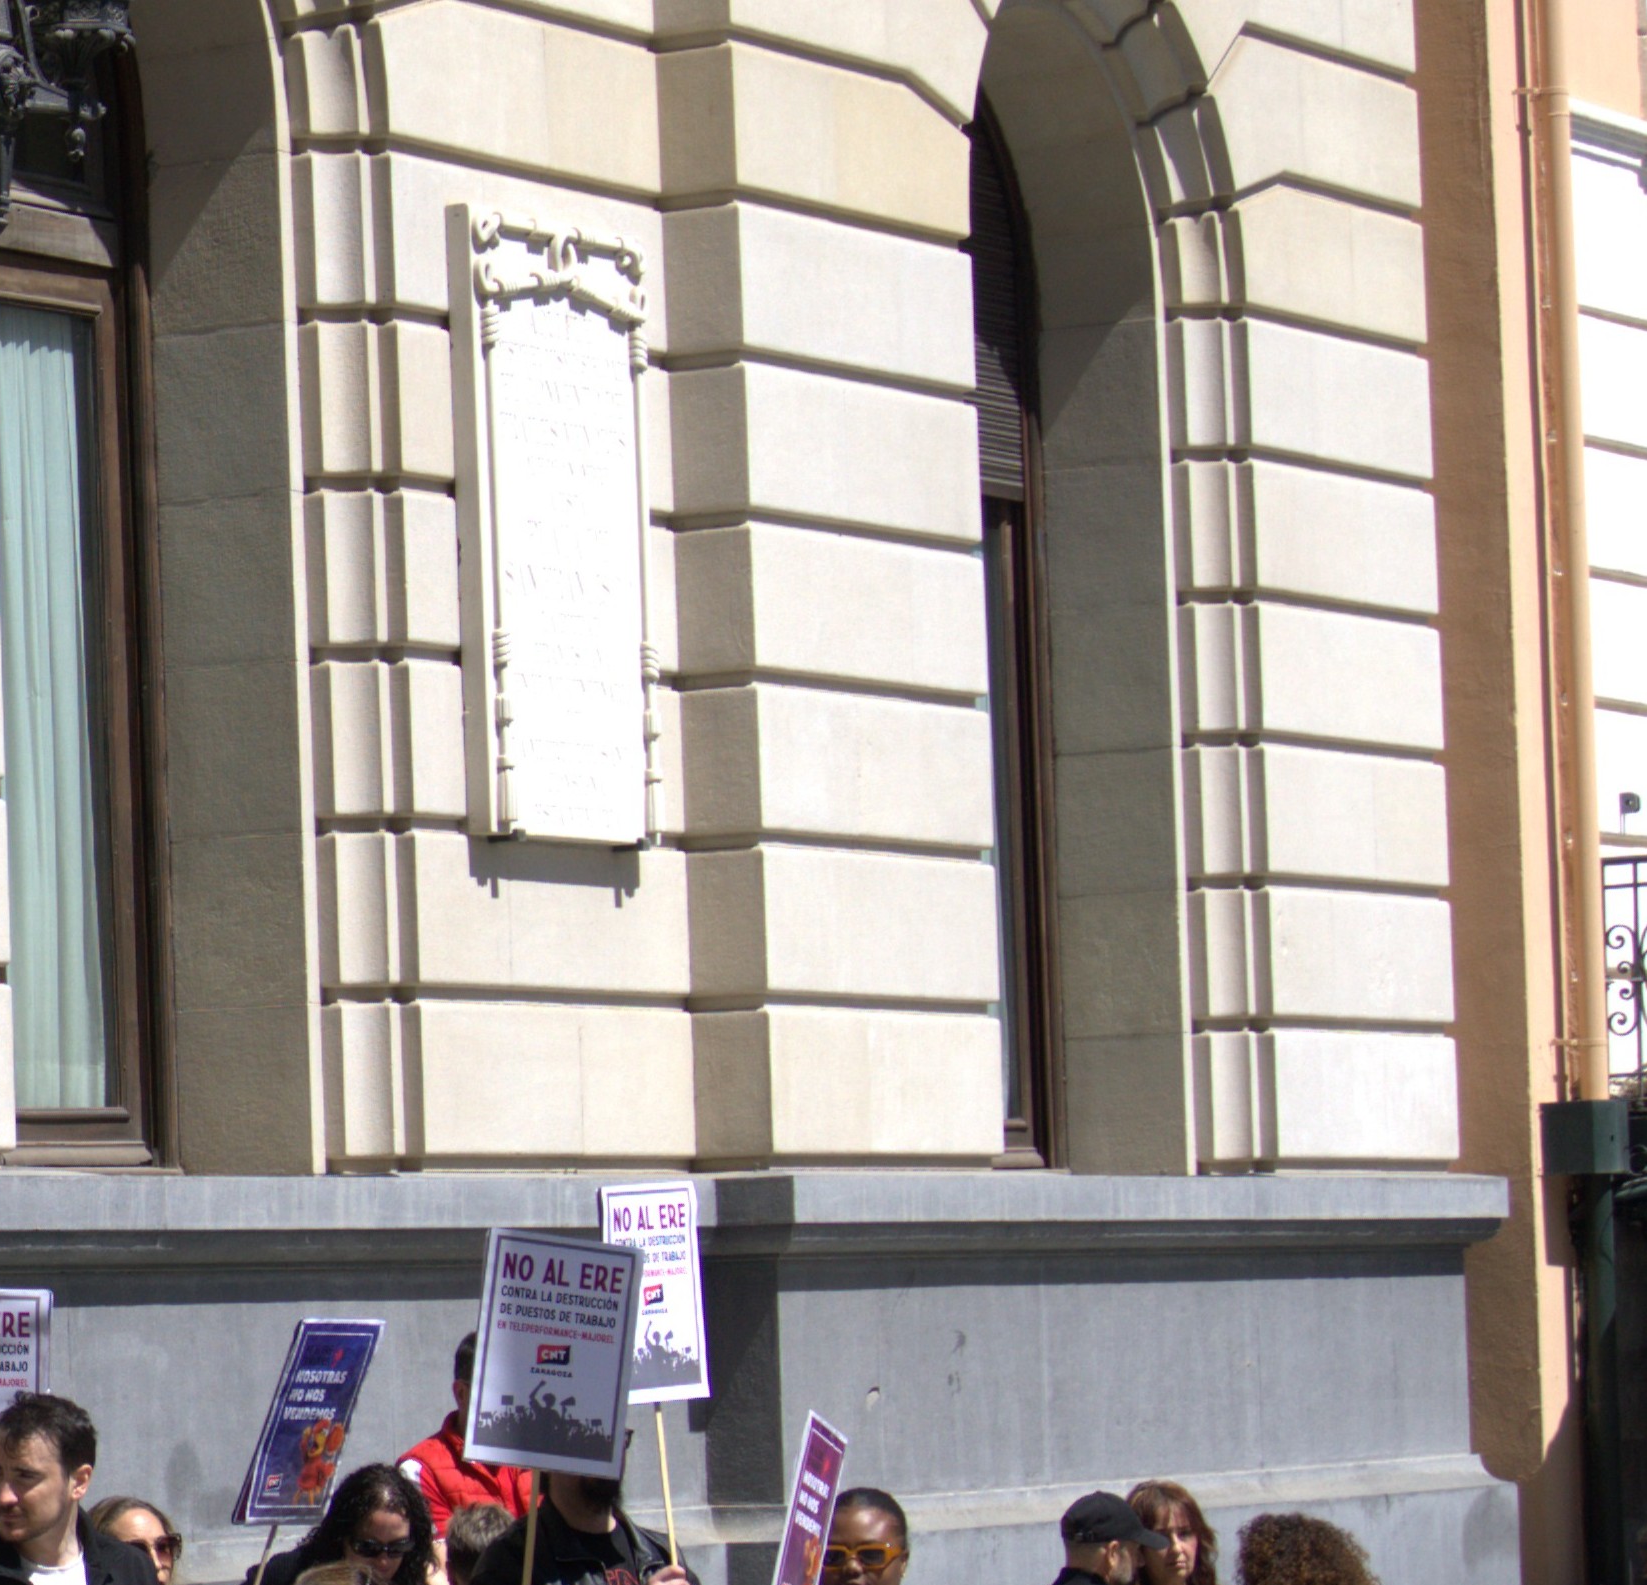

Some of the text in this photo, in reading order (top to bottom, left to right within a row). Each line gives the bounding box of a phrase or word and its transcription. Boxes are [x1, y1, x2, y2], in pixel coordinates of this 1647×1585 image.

[613, 1203, 686, 1232] NO AL ERE
[502, 1251, 625, 1294] NO AL ERE
[501, 1284, 619, 1312] CONTRA LA DESTRUCCIÓN
[497, 1319, 507, 1329] EN
[499, 1302, 616, 1329] DE PUESTOS DE TRABAJO
[295, 1370, 348, 1385] NOSOTRAS
[289, 1388, 327, 1402] NO NOS
[283, 1406, 337, 1421] VENDEMOS
